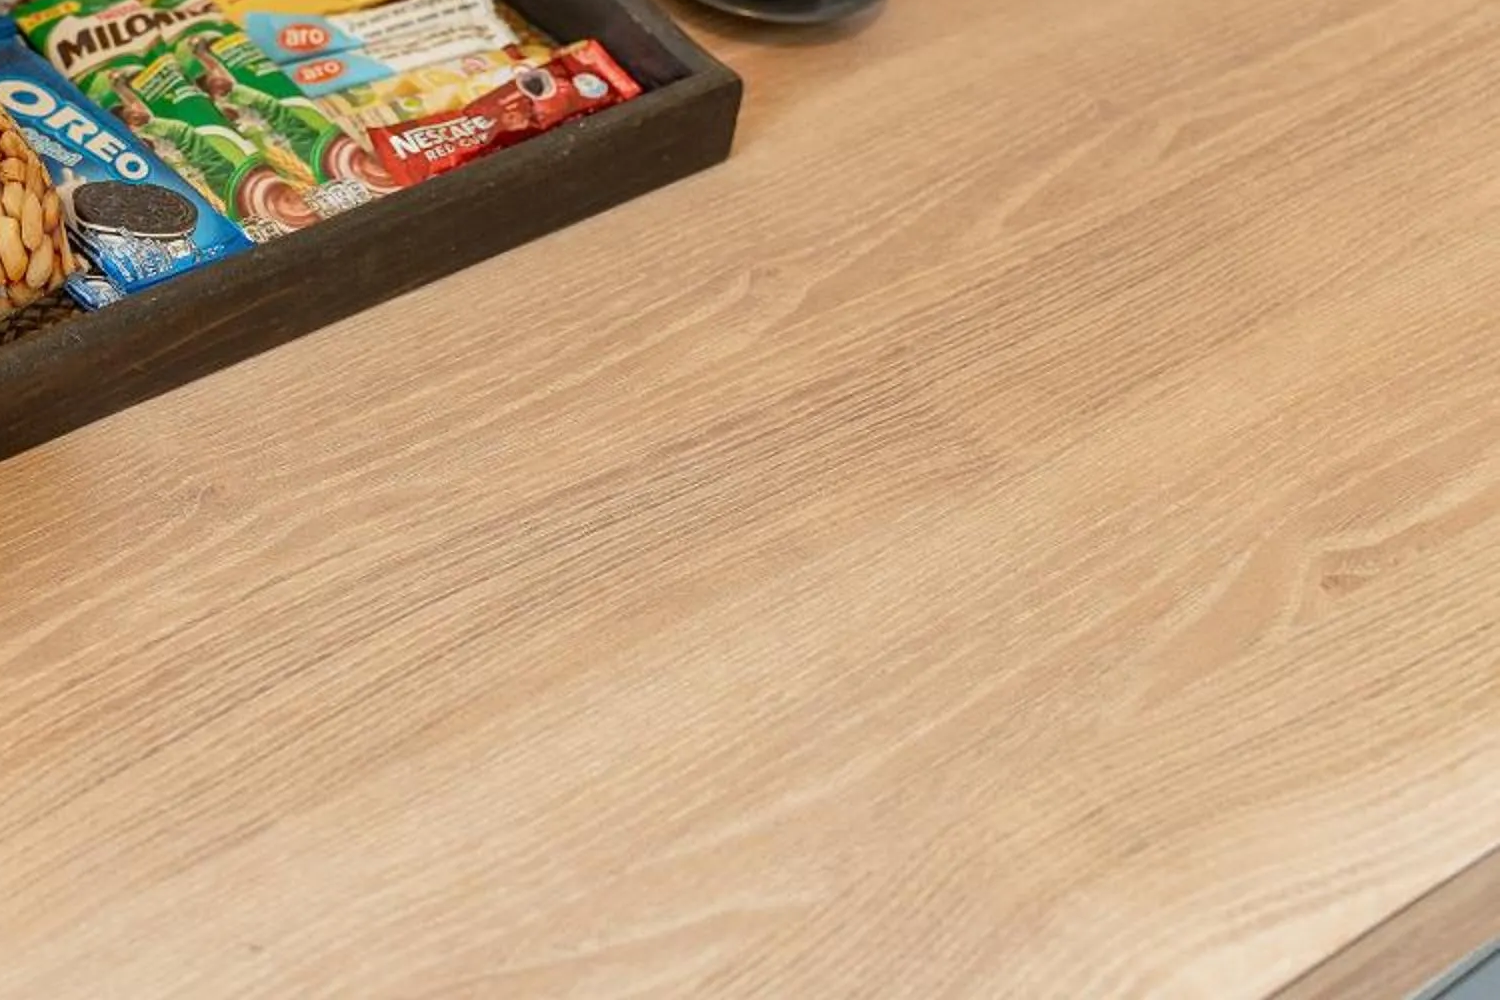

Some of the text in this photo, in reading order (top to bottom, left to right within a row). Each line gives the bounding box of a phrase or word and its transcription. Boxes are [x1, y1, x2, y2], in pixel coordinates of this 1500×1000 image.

[56, 13, 156, 70] MILO
[283, 27, 325, 47] aro
[300, 59, 342, 80] aro
